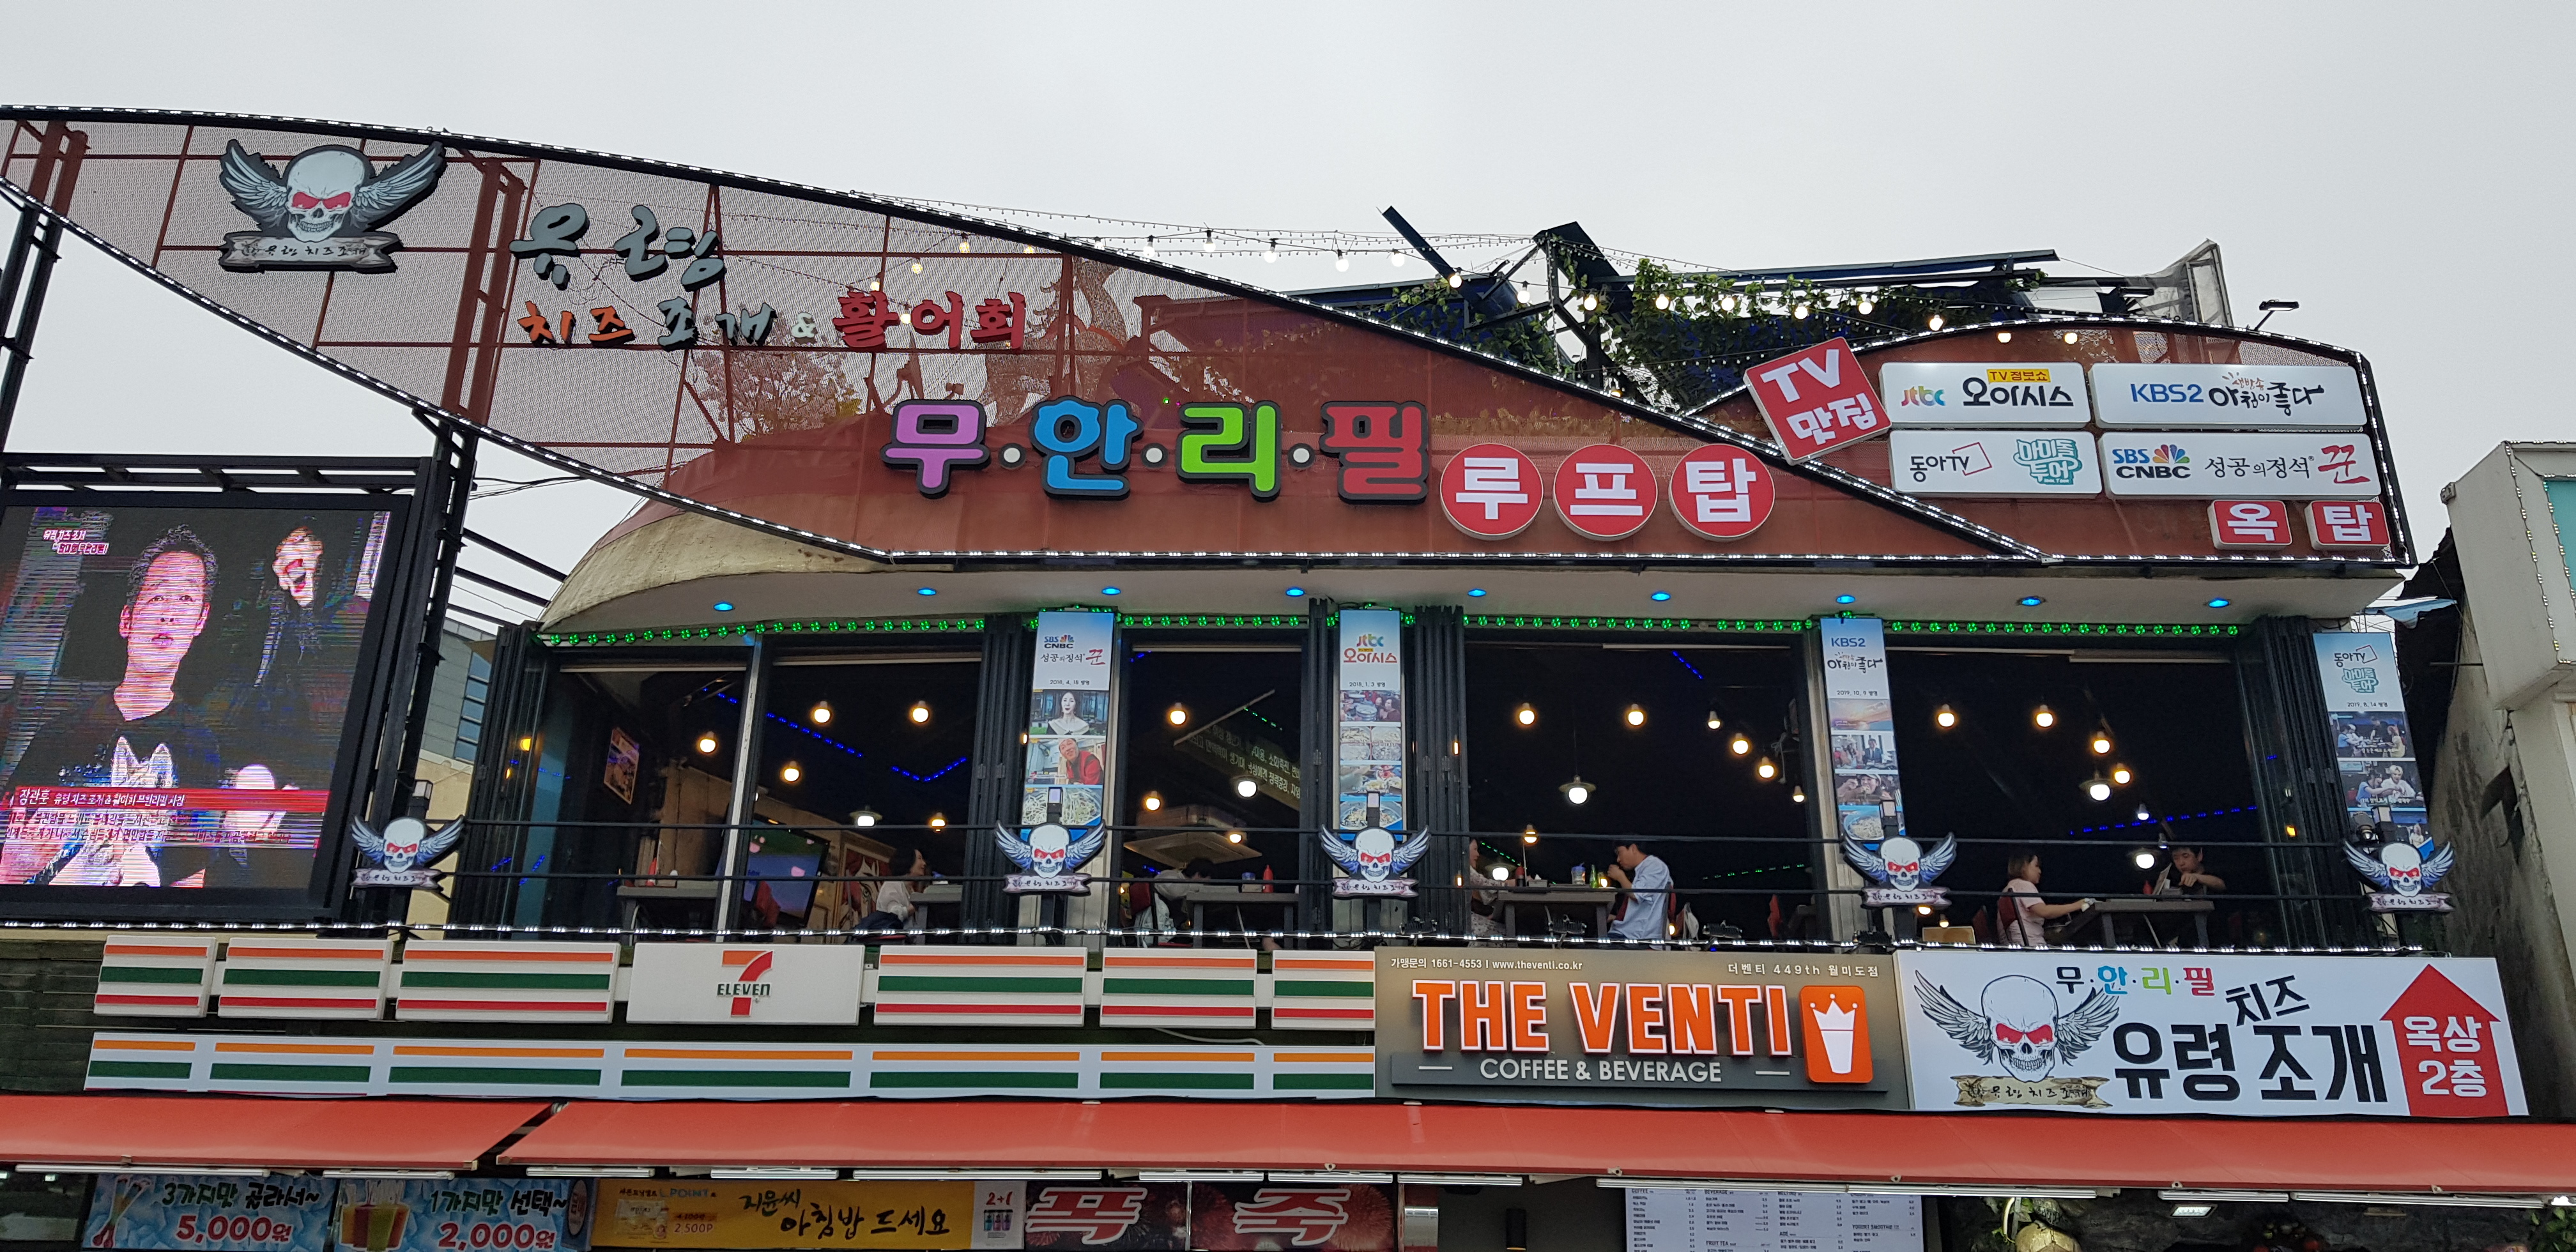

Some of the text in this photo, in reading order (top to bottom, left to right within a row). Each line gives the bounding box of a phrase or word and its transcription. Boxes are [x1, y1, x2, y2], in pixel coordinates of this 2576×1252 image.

[518, 290, 1027, 352] 치즈 조개 & 활어회
[1760, 349, 1841, 403] TV
[1989, 370, 2048, 381] TV 정보쇼
[1901, 377, 2074, 406] jtbc 오아시스
[2130, 383, 2204, 402] KBS2
[2112, 449, 2150, 464] SBS
[2318, 445, 2371, 484] 꾼
[2116, 466, 2191, 478] CNBC
[1344, 648, 1397, 663] 오아시스
[1831, 637, 1866, 647] KBS2
[1391, 958, 1427, 968] 가맹문의
[1431, 959, 1482, 968] 1661-4553
[1728, 963, 1879, 977] 더벤티 449th 월미도점
[722, 950, 773, 1017] 7
[2225, 975, 2310, 1027] 치즈
[1412, 979, 1793, 1058] THE VENTI
[2404, 1016, 2481, 1053] 옥상
[1480, 1058, 1722, 1082] COFFEE & BEVERAGE
[2113, 1022, 2388, 1103] 유령 조개
[2418, 1058, 2487, 1097] 2층
[2029, 1087, 2058, 1098] 치즈
[162, 1182, 237, 1209] 3가지맛
[430, 1189, 504, 1215] 1가지맛
[739, 1188, 801, 1216] 지윤씨
[986, 1191, 1013, 1205] 2+1
[176, 1215, 293, 1244] 5,000원
[674, 1223, 713, 1234] 2,500P
[780, 1202, 950, 1240] 아침밥 드세요
[438, 1221, 556, 1252] 2,000원
